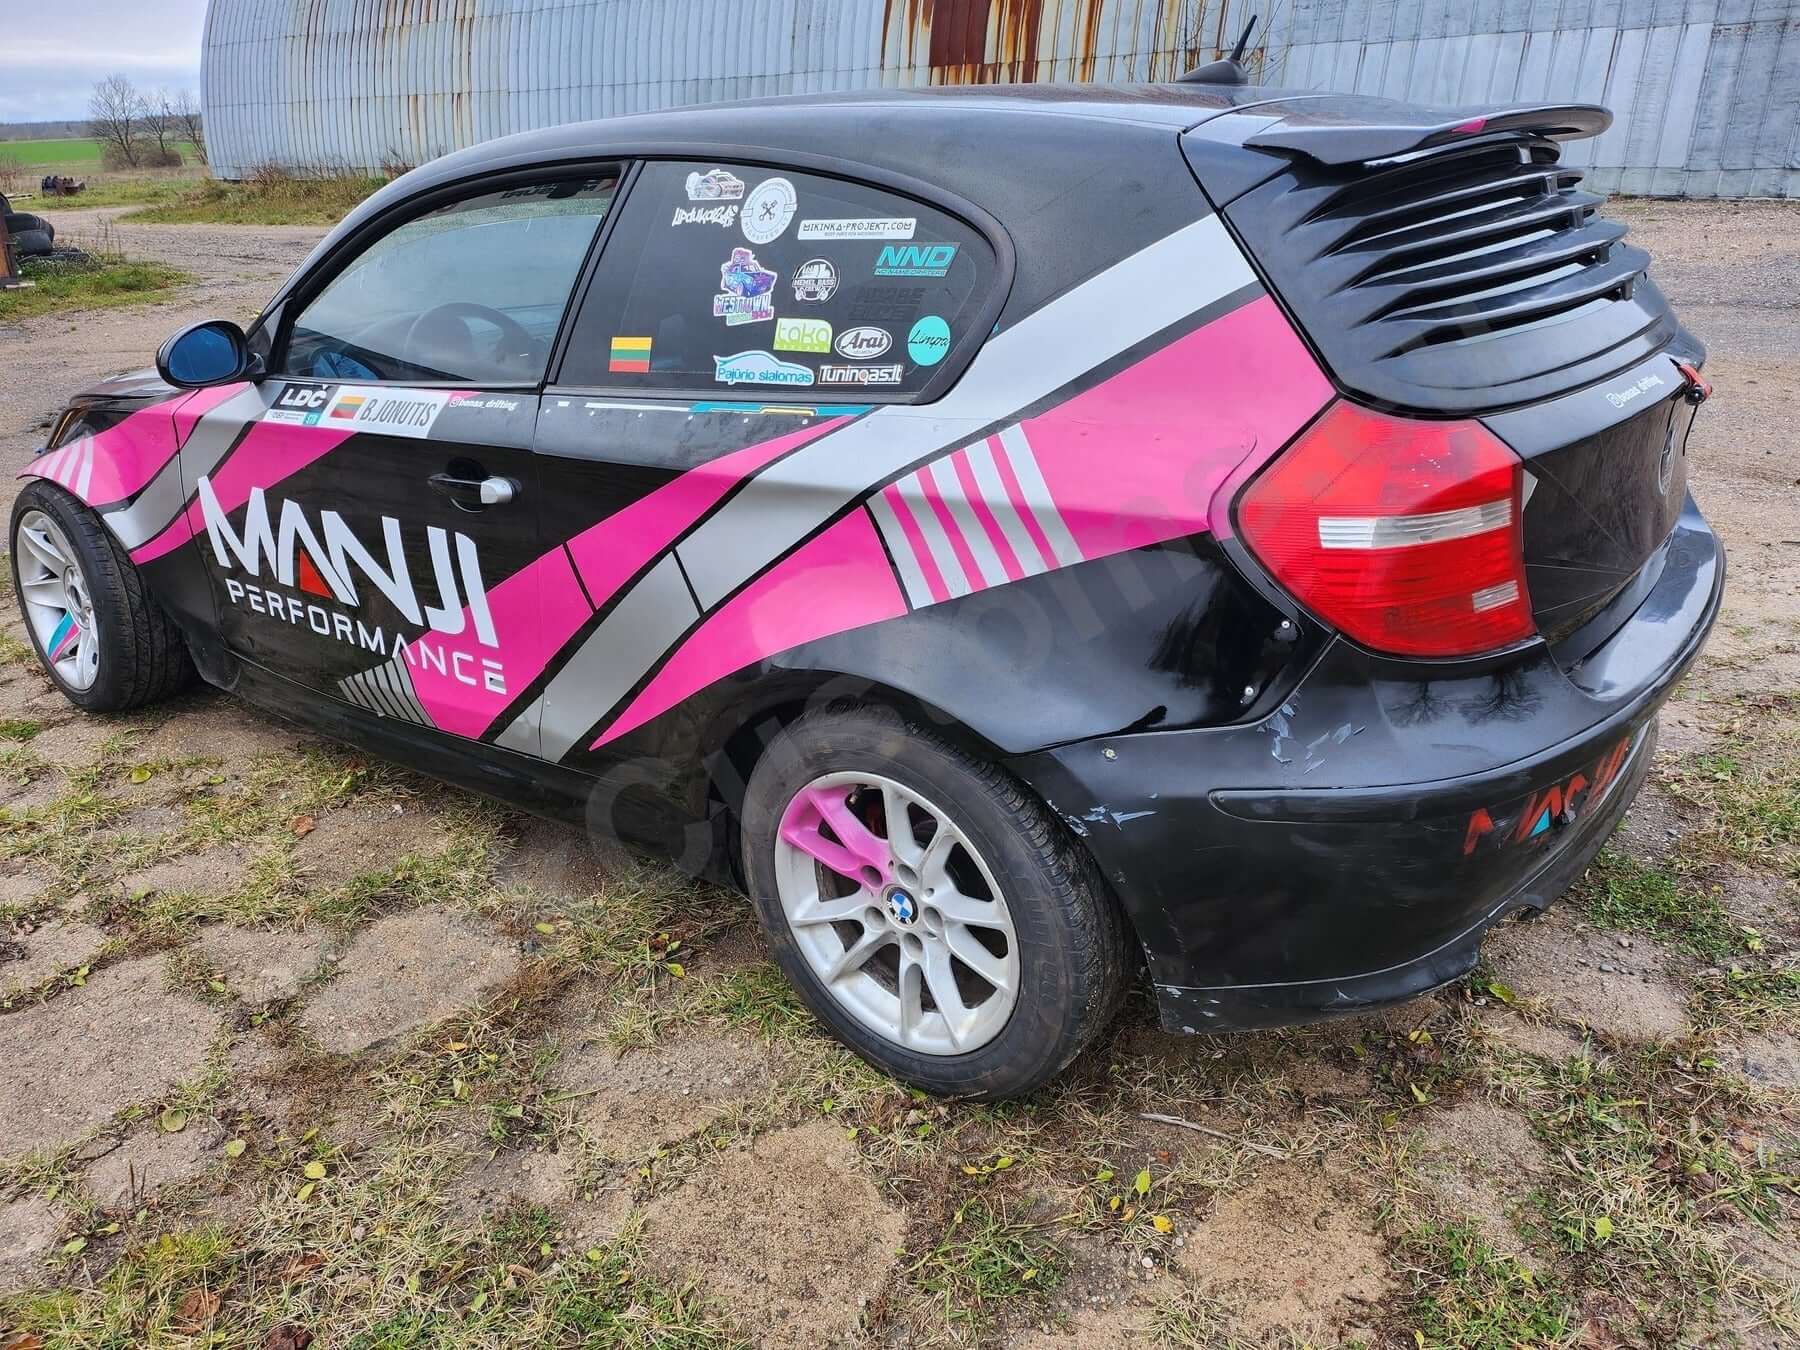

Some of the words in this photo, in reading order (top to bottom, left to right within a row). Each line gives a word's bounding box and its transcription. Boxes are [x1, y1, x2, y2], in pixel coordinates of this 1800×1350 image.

[876, 245, 956, 267] NND
[840, 331, 885, 349] Arai
[279, 384, 329, 408] LDČ
[361, 398, 437, 427] B.JONUTIS
[197, 475, 500, 649] MANJI
[225, 578, 507, 695] PERFORMANCE
